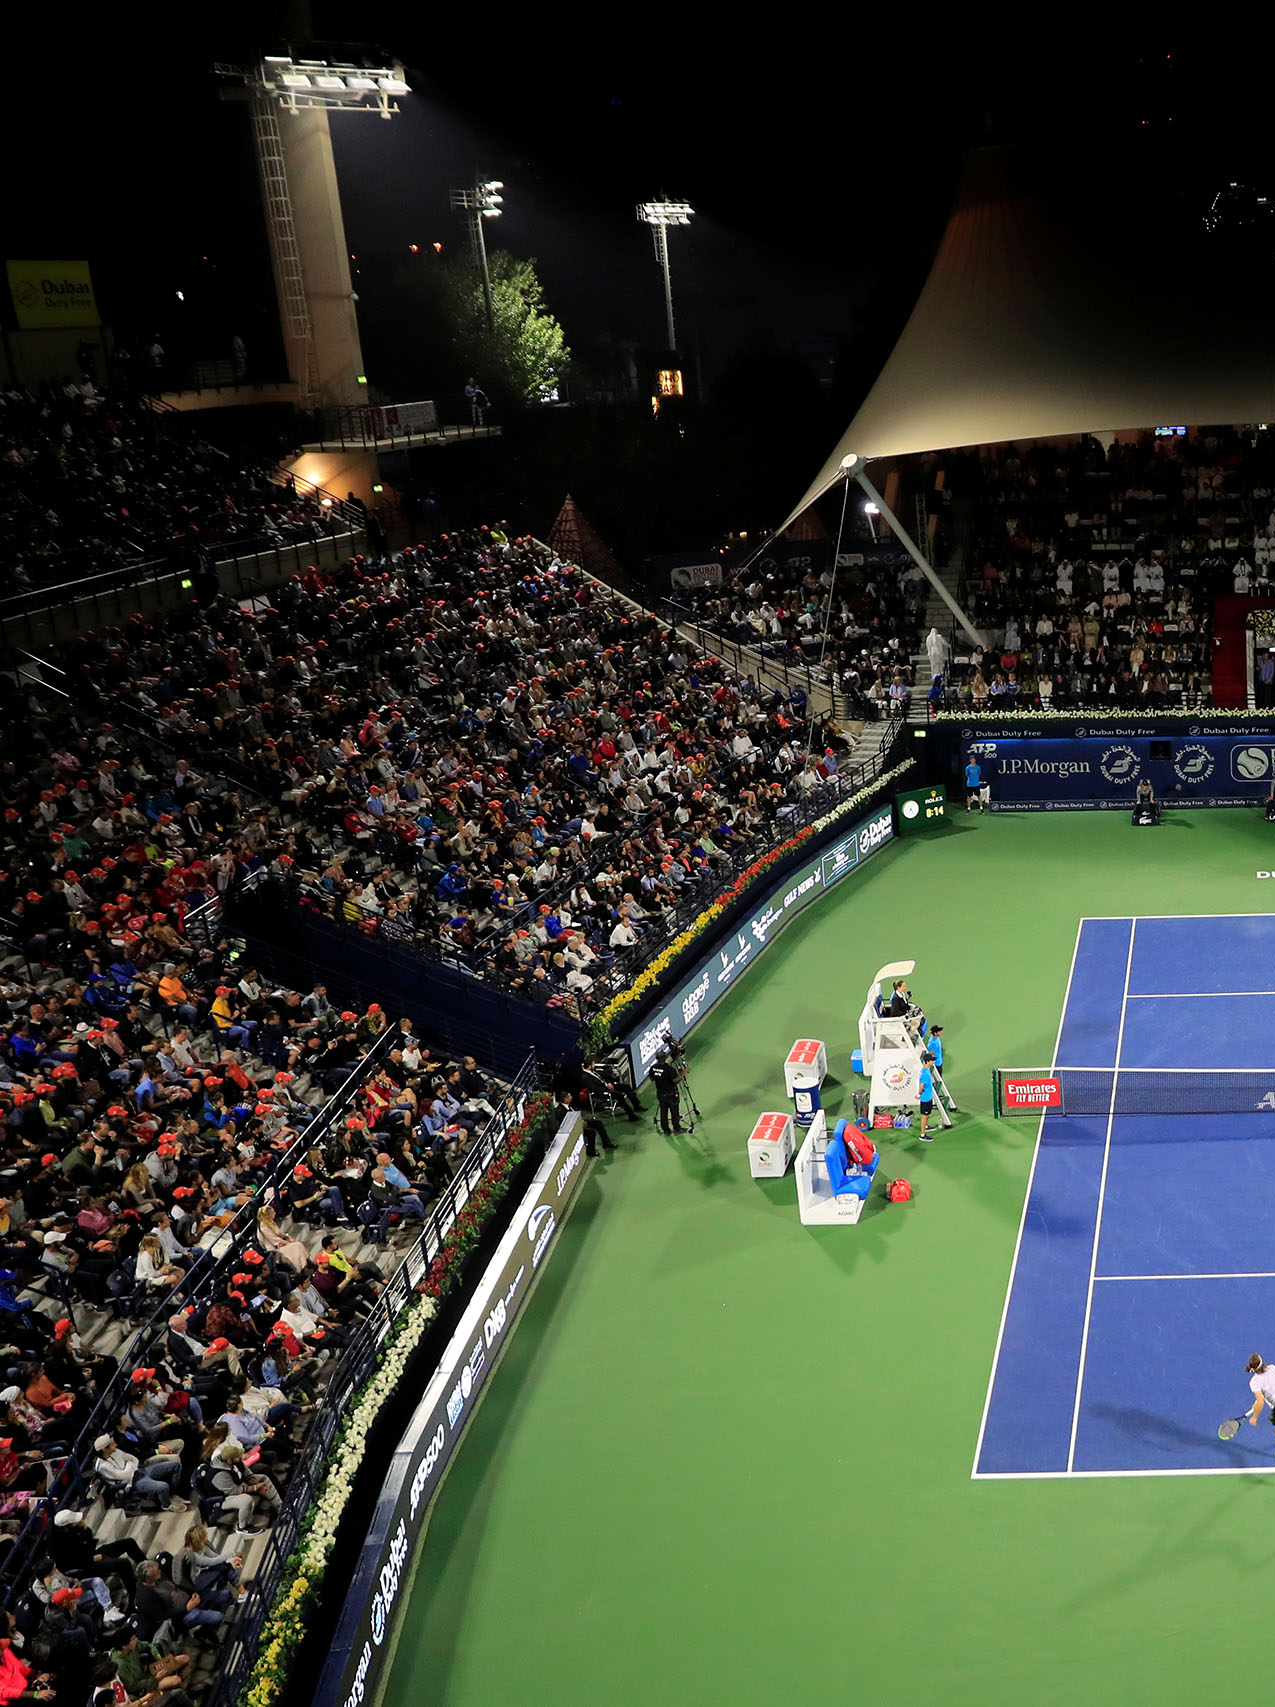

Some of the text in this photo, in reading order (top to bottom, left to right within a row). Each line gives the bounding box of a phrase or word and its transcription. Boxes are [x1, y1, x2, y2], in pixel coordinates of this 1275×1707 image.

[41, 279, 90, 294] Dubai
[1116, 729, 1135, 737] Duty
[1230, 728, 1250, 736] Duty
[967, 743, 997, 754] ATP
[998, 758, 1090, 778] J.P.Morgan
[925, 796, 944, 804] ROLEX
[869, 814, 891, 836] Dubai
[1008, 1084, 1056, 1094] Emirates
[1016, 1094, 1050, 1102] FLY BETTER
[380, 1518, 405, 1599] Dubai
